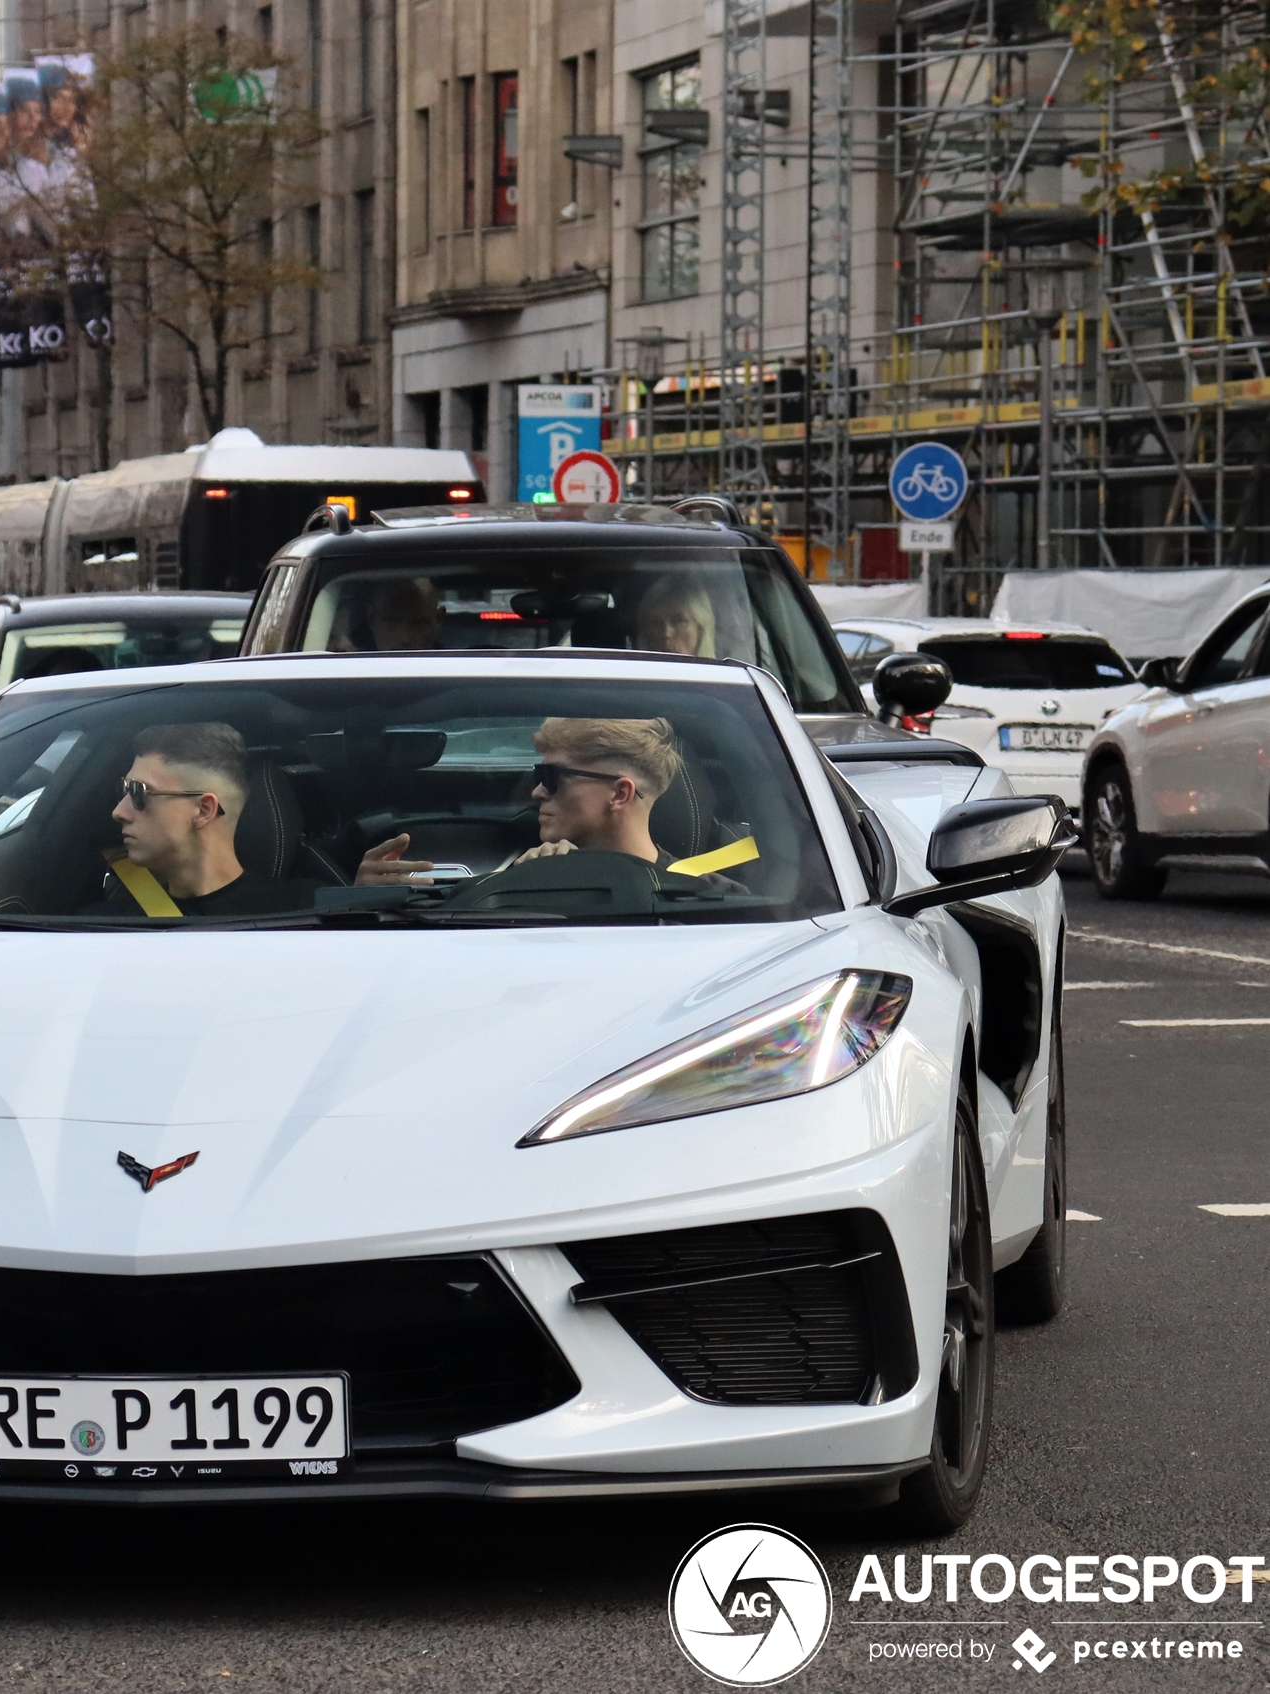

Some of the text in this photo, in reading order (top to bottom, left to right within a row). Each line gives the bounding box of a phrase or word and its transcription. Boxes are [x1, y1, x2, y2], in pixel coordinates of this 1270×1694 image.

[527, 392, 562, 400] APCOA
[911, 530, 944, 542] Ende
[111, 1388, 152, 1450] P
[170, 1385, 334, 1450] 1199
[197, 1467, 222, 1475] ISUZU
[288, 1460, 339, 1476] WIENS
